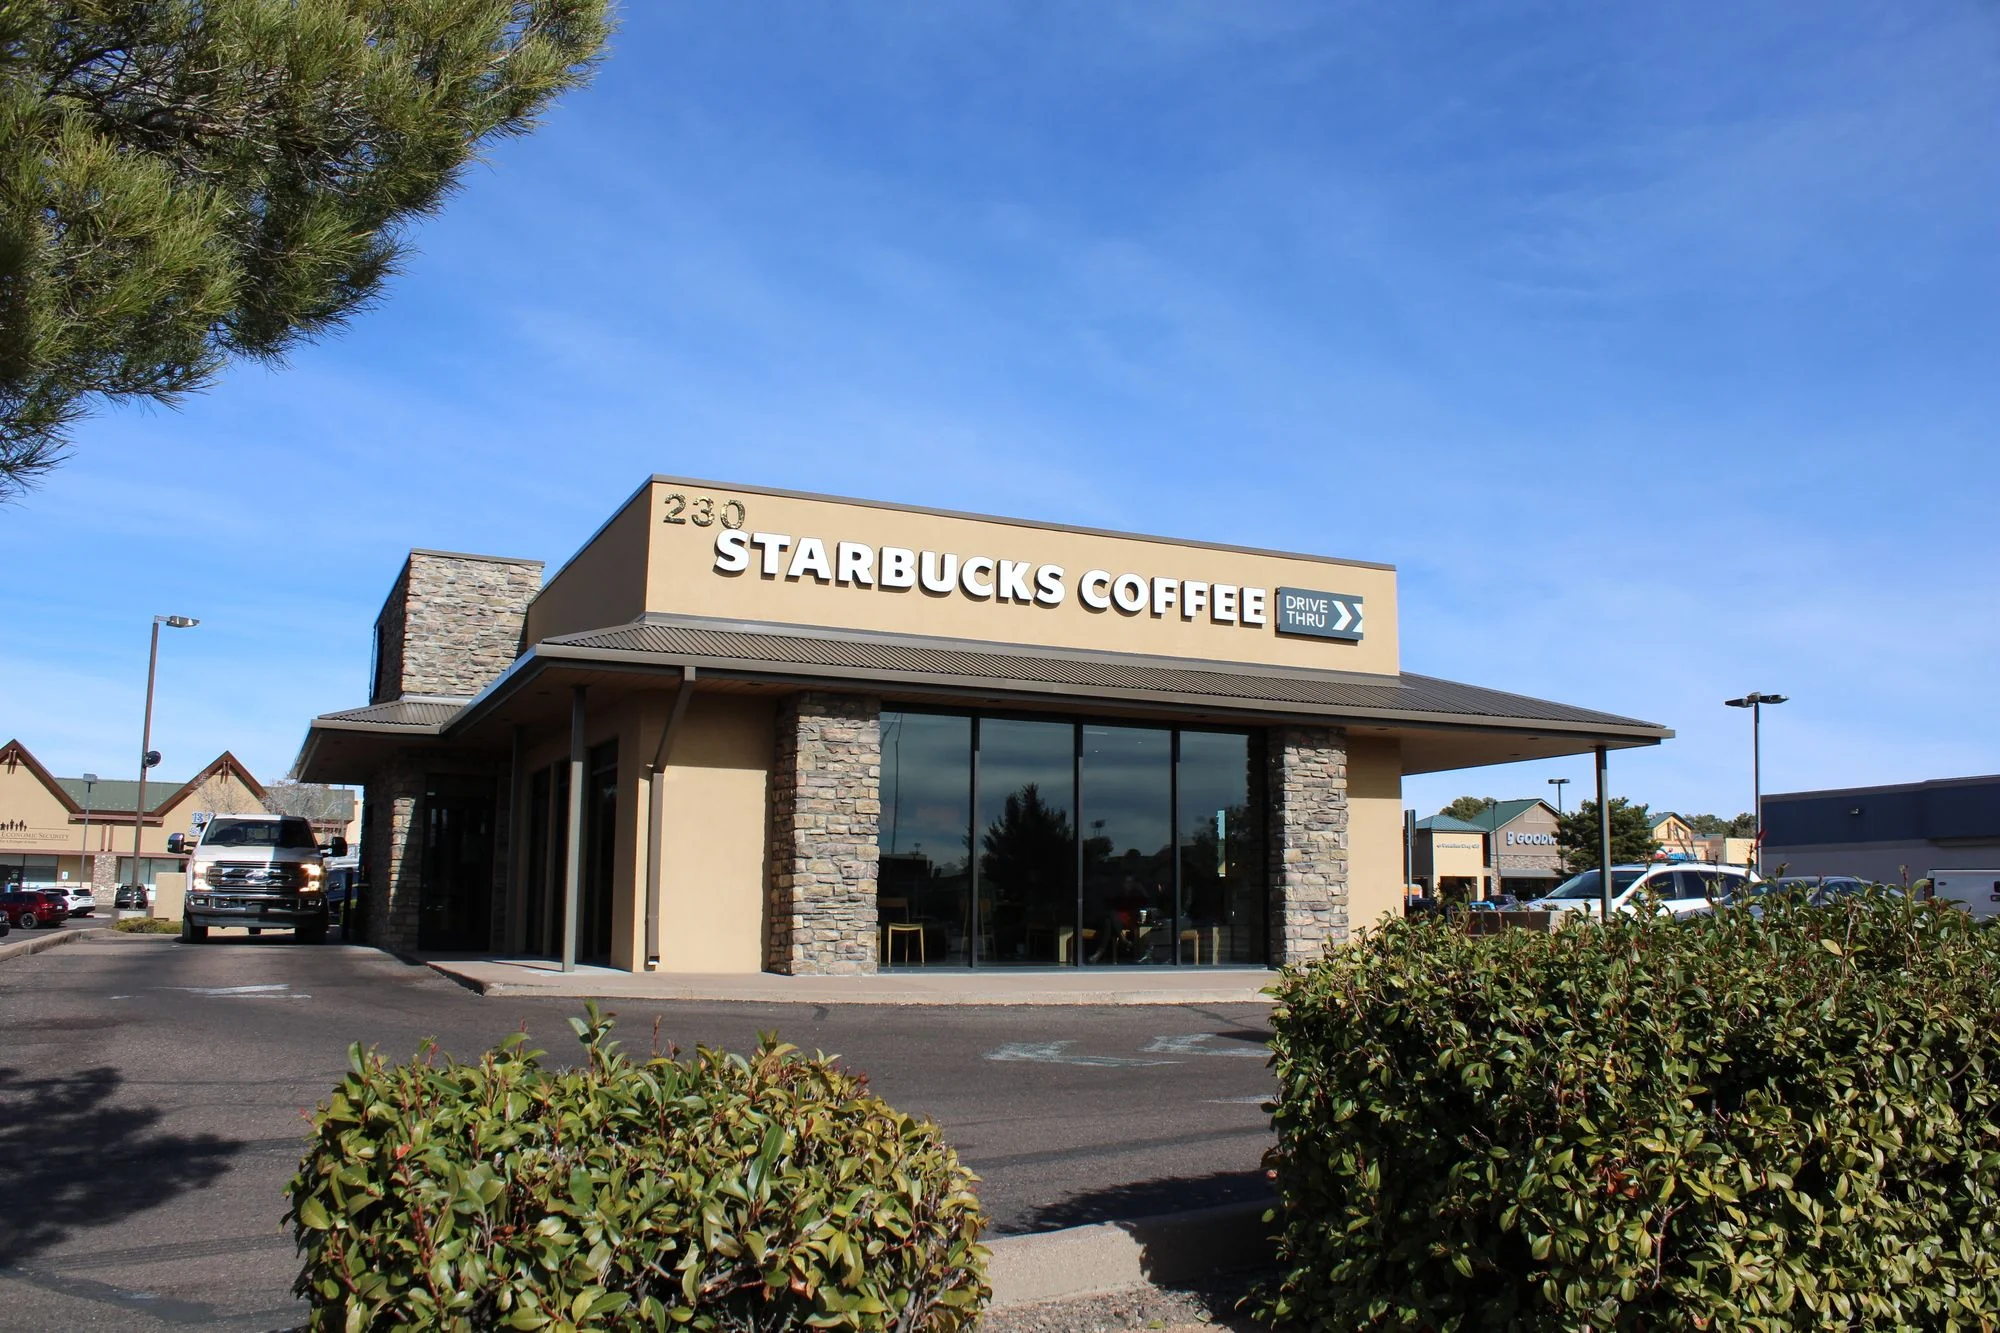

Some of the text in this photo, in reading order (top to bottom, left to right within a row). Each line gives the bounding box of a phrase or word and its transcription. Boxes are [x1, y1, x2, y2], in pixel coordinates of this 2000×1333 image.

[663, 493, 746, 529] 230
[713, 528, 1267, 626] STARBUCKS COFFEE
[1285, 595, 1328, 613] DRIVE
[1286, 610, 1325, 628] THRU
